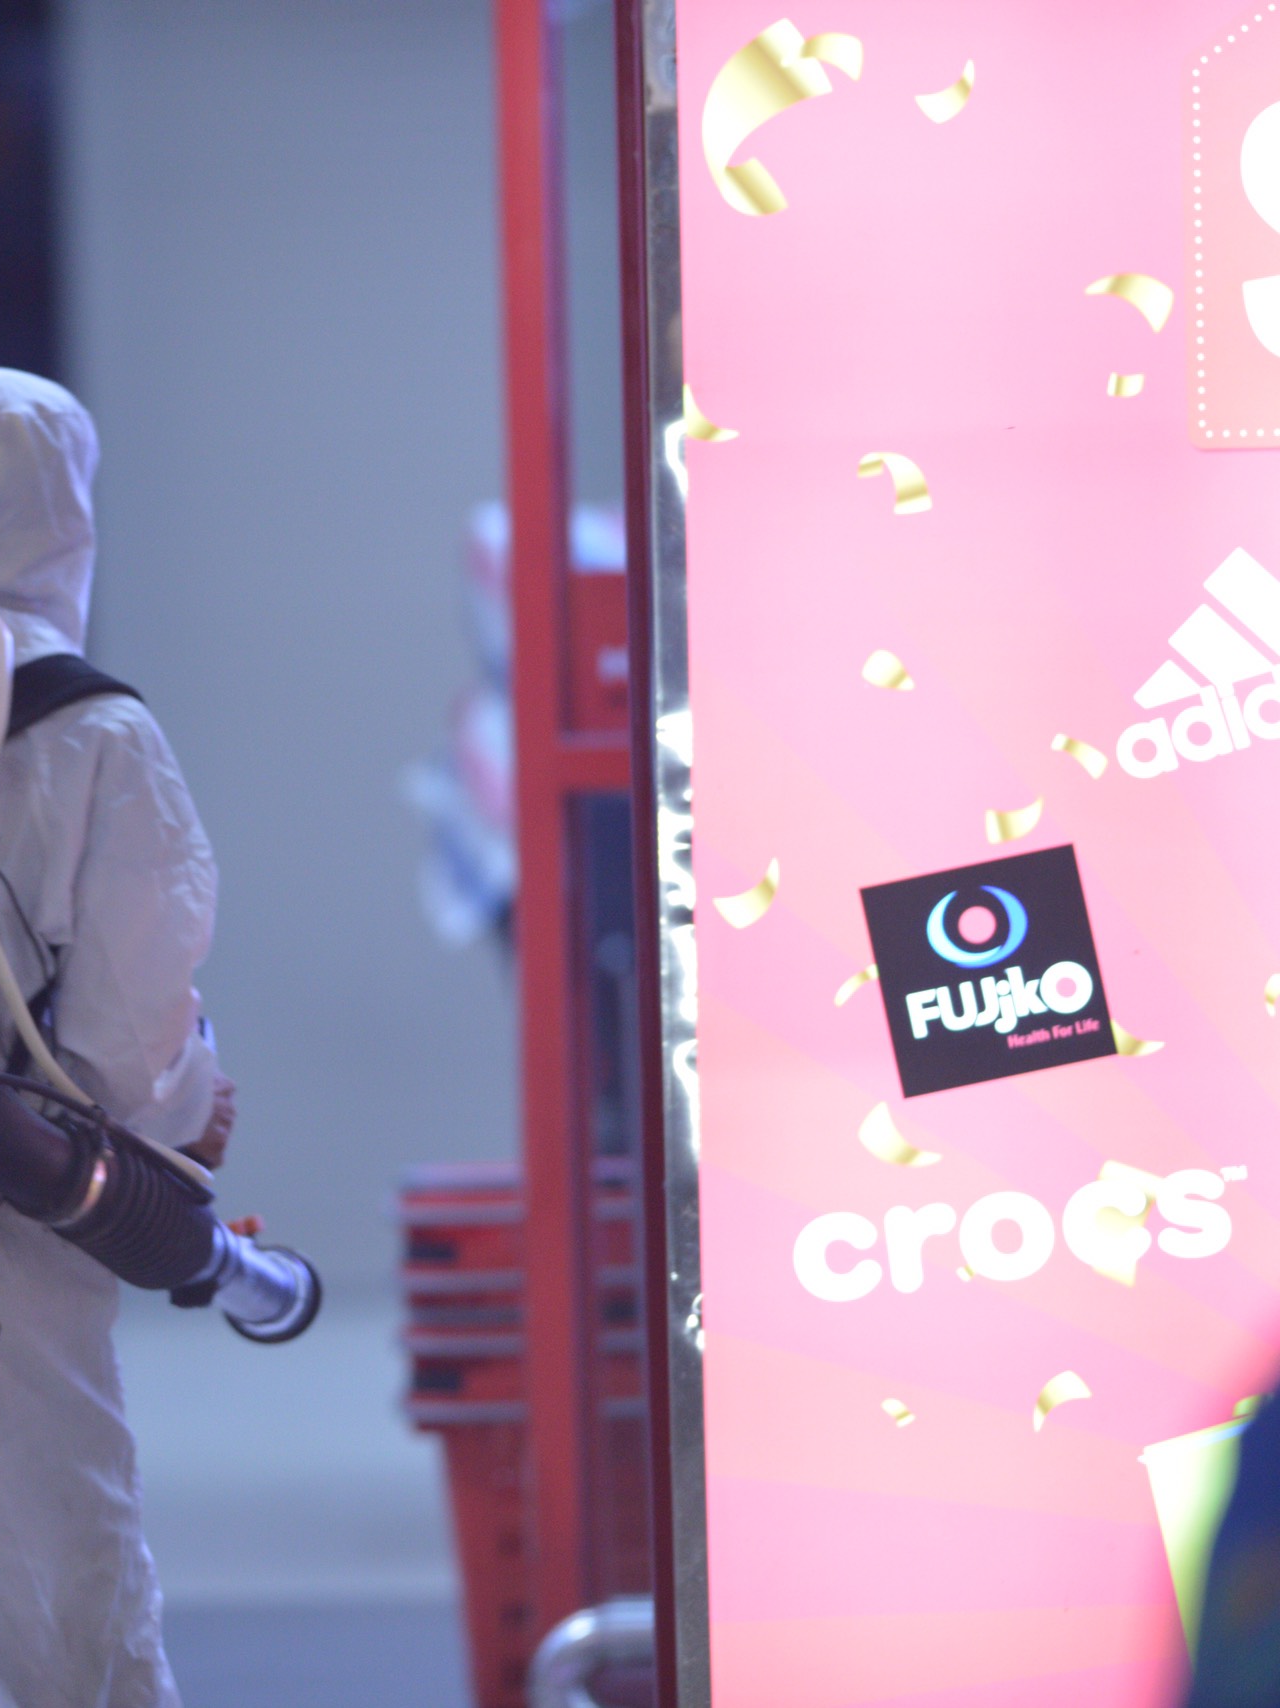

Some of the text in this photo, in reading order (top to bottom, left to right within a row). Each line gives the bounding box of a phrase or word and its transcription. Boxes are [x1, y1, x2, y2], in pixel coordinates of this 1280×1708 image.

[1007, 1018, 1101, 1049] Health For Life
[793, 1169, 1233, 1302] crocs
